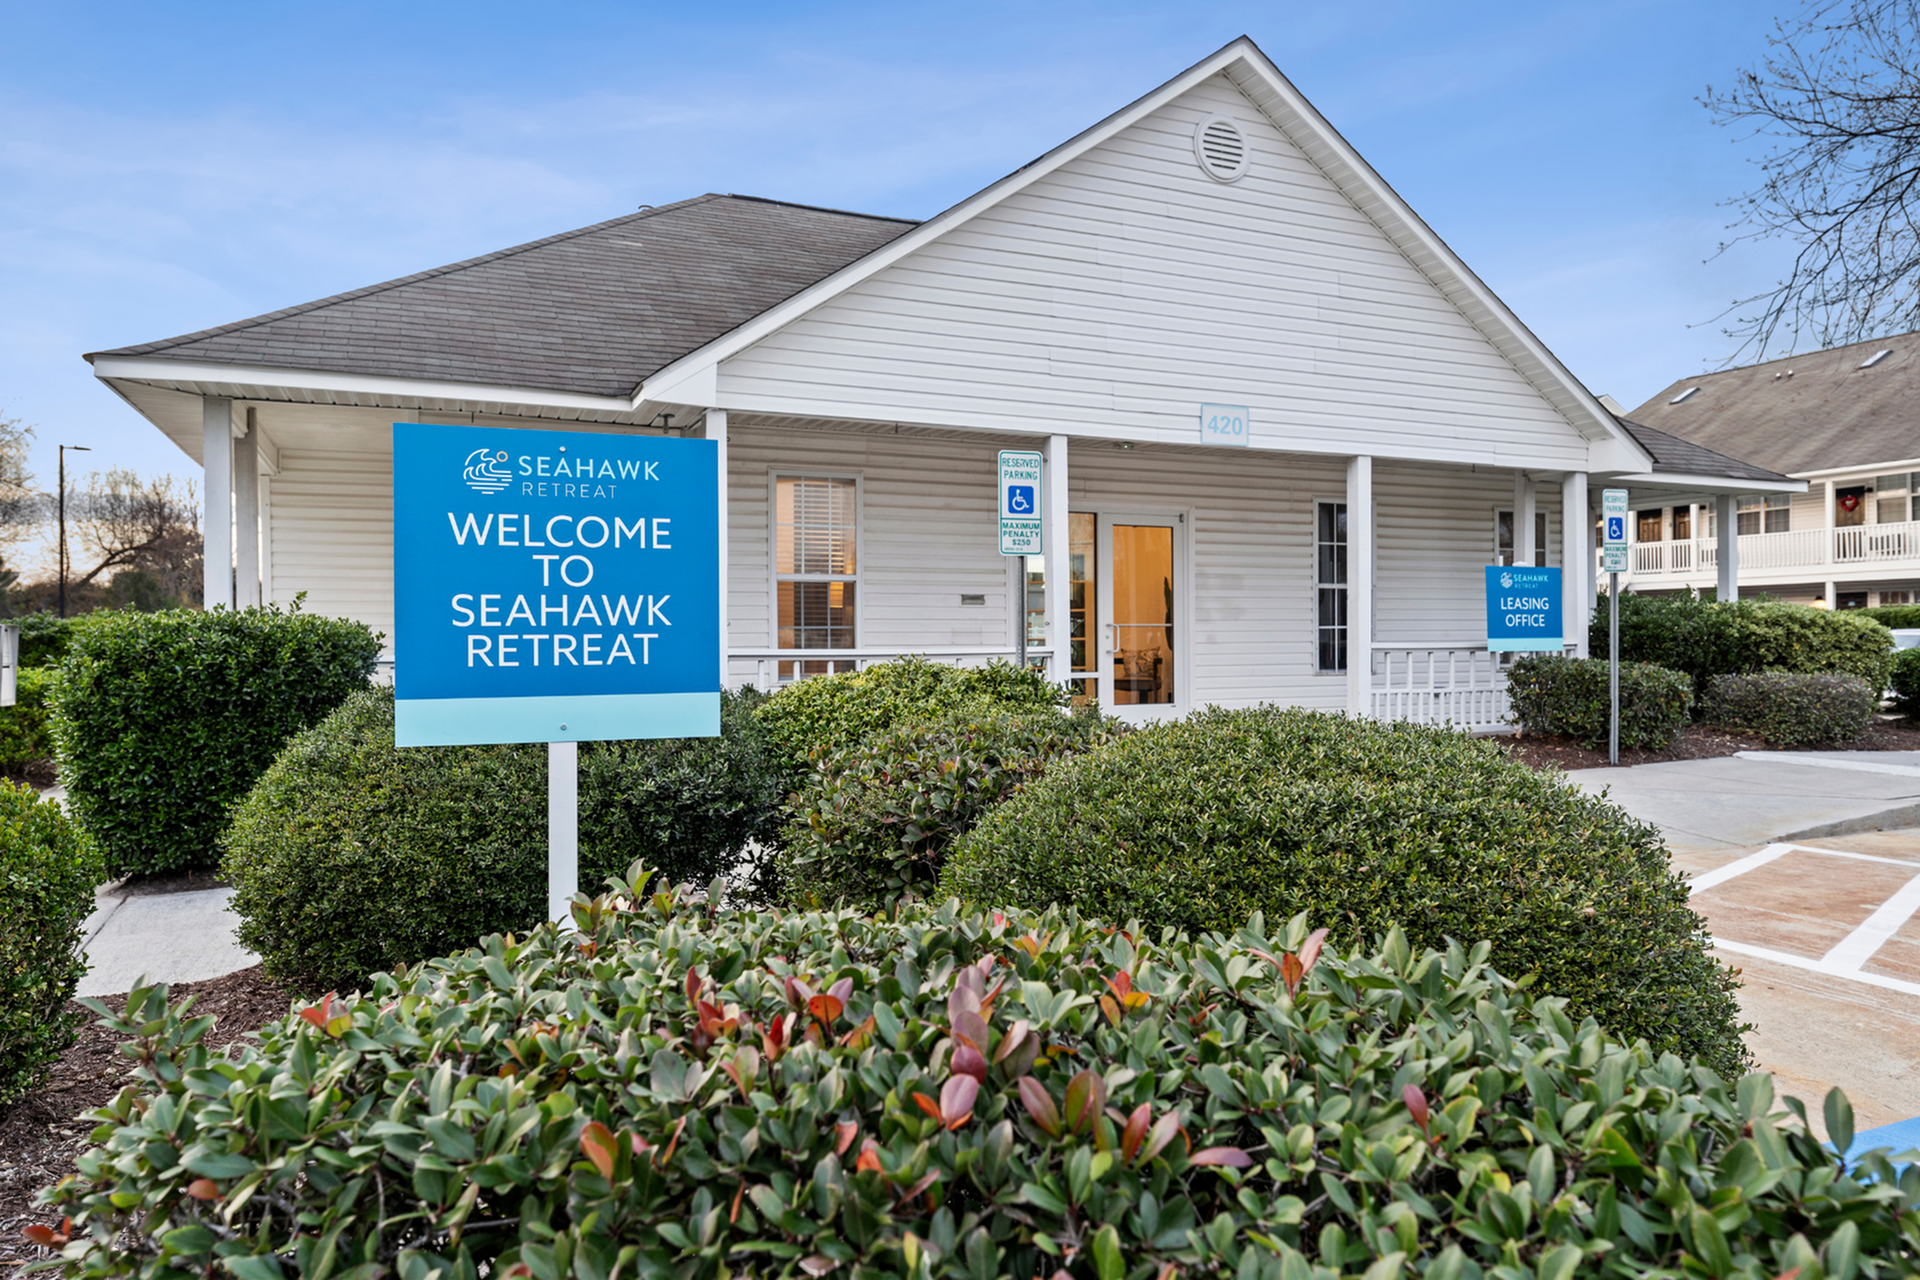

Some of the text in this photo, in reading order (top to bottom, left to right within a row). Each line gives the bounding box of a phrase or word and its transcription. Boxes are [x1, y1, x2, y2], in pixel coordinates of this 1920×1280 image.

[1207, 415, 1243, 435] 420
[518, 455, 660, 481] SEAHAWK
[1001, 457, 1040, 468] RESERVED
[1003, 470, 1038, 480] PARKING
[522, 482, 617, 499] RETREAT
[447, 512, 672, 549] WELCOME
[1002, 522, 1040, 530] MAXIMUM
[1002, 530, 1040, 538] PENALTY
[532, 554, 594, 587] TO
[1513, 574, 1549, 583] SEAHAWK
[451, 594, 672, 627] SEAHAWK
[1500, 597, 1549, 610] LEASING
[1505, 614, 1546, 627] OFFICE
[467, 633, 659, 667] RETREAT
